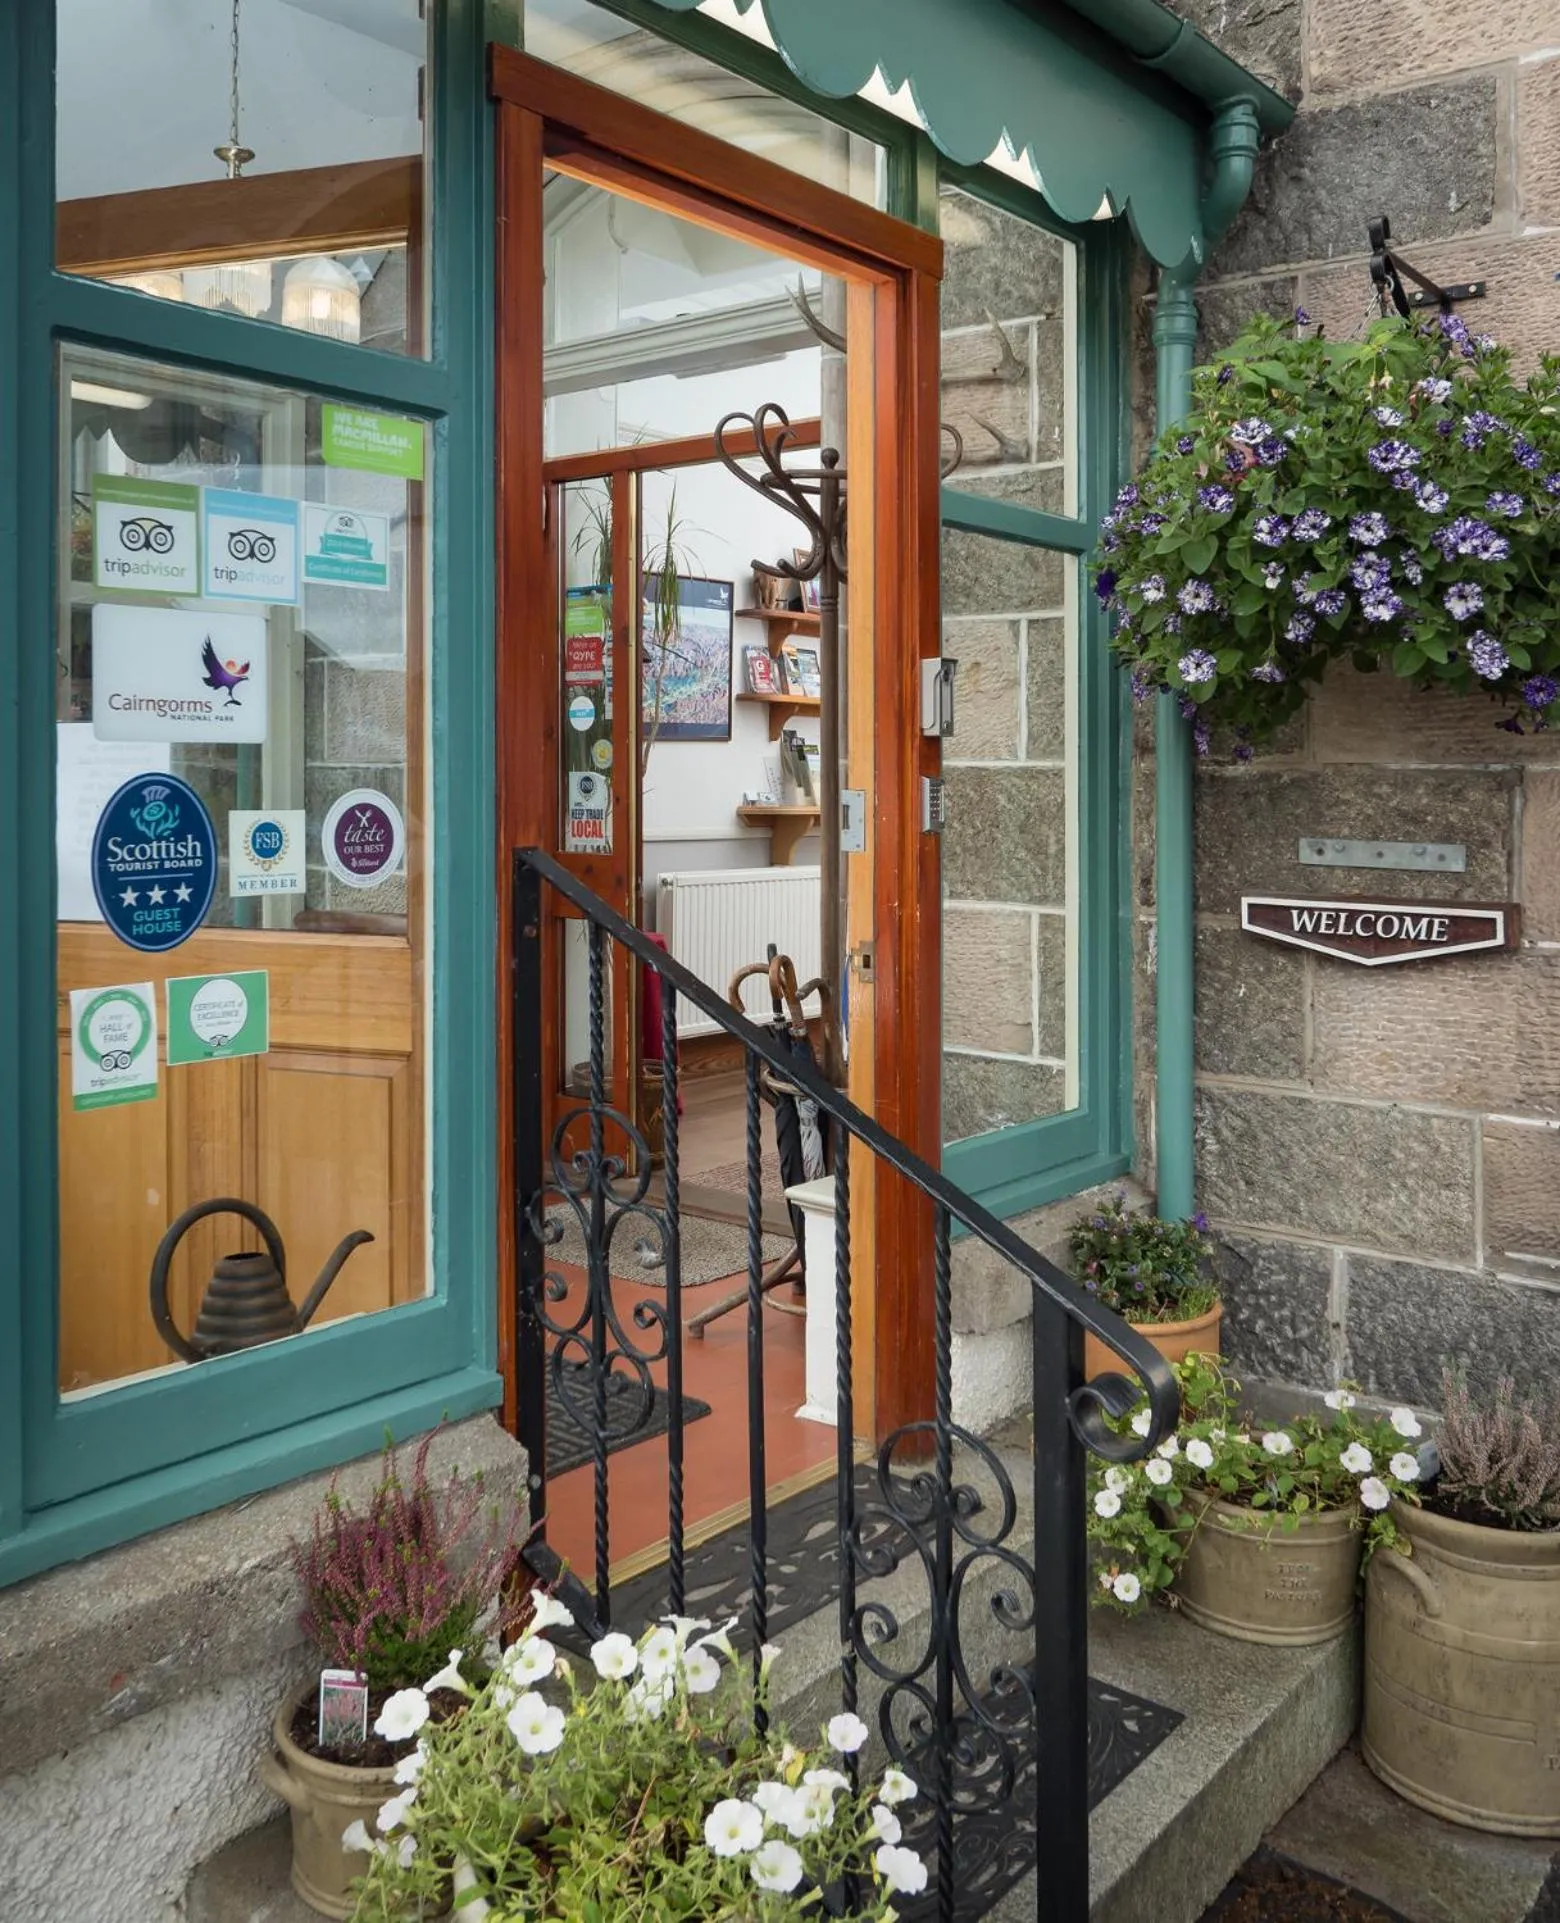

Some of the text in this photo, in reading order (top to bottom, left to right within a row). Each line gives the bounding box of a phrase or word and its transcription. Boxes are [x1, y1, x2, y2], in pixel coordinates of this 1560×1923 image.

[104, 558, 187, 578] tripadvisor
[213, 566, 285, 585] tripadvisor
[108, 693, 213, 717] Cairngorms
[170, 714, 212, 722] NATIONAL
[344, 822, 386, 843] taste
[571, 820, 604, 838] LOCAL
[106, 834, 203, 862] Scottish
[255, 831, 280, 849] FSB
[343, 844, 384, 854] OUR BEST
[108, 859, 203, 872] TOURIST BOARD
[238, 879, 297, 890] MEMBER
[133, 908, 181, 922] GUEST
[132, 921, 182, 936] HOUSE
[1290, 908, 1449, 942] WELCOME
